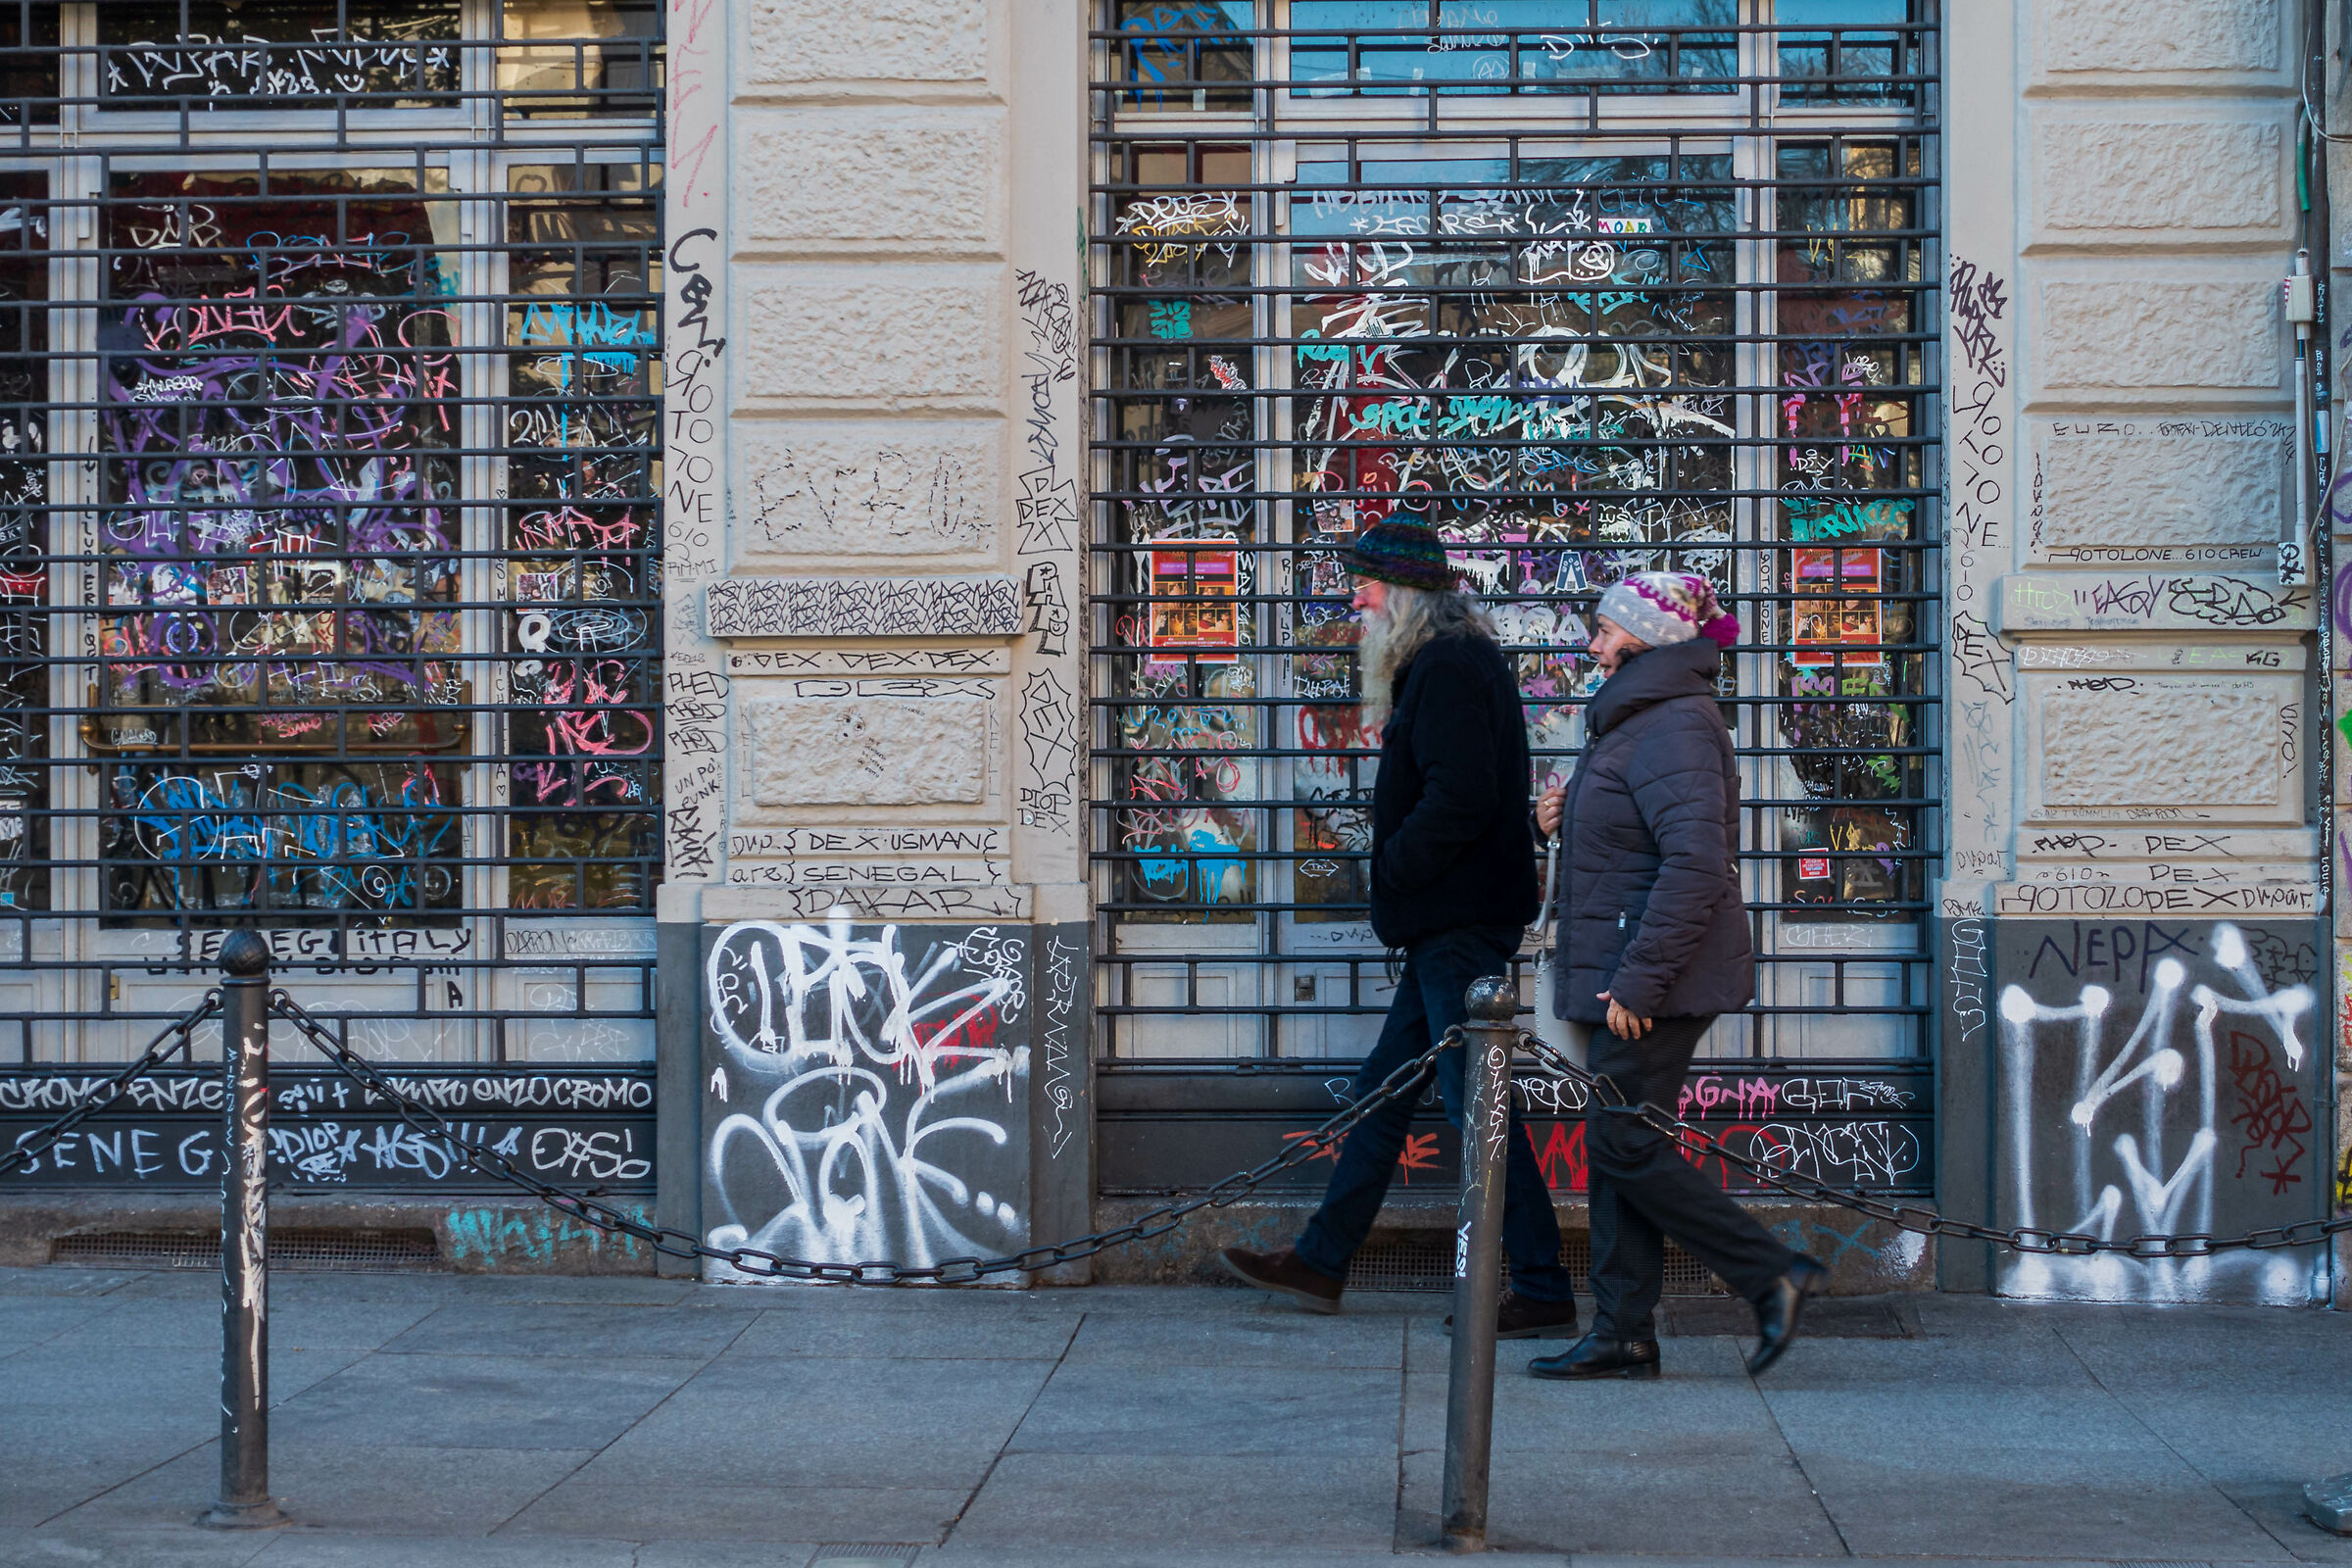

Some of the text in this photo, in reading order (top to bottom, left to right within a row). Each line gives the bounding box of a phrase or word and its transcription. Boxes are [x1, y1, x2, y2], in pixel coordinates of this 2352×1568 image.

[1598, 220, 1648, 233] MOAR
[890, 831, 981, 851] USMAN
[803, 865, 981, 883] SENEGAL
